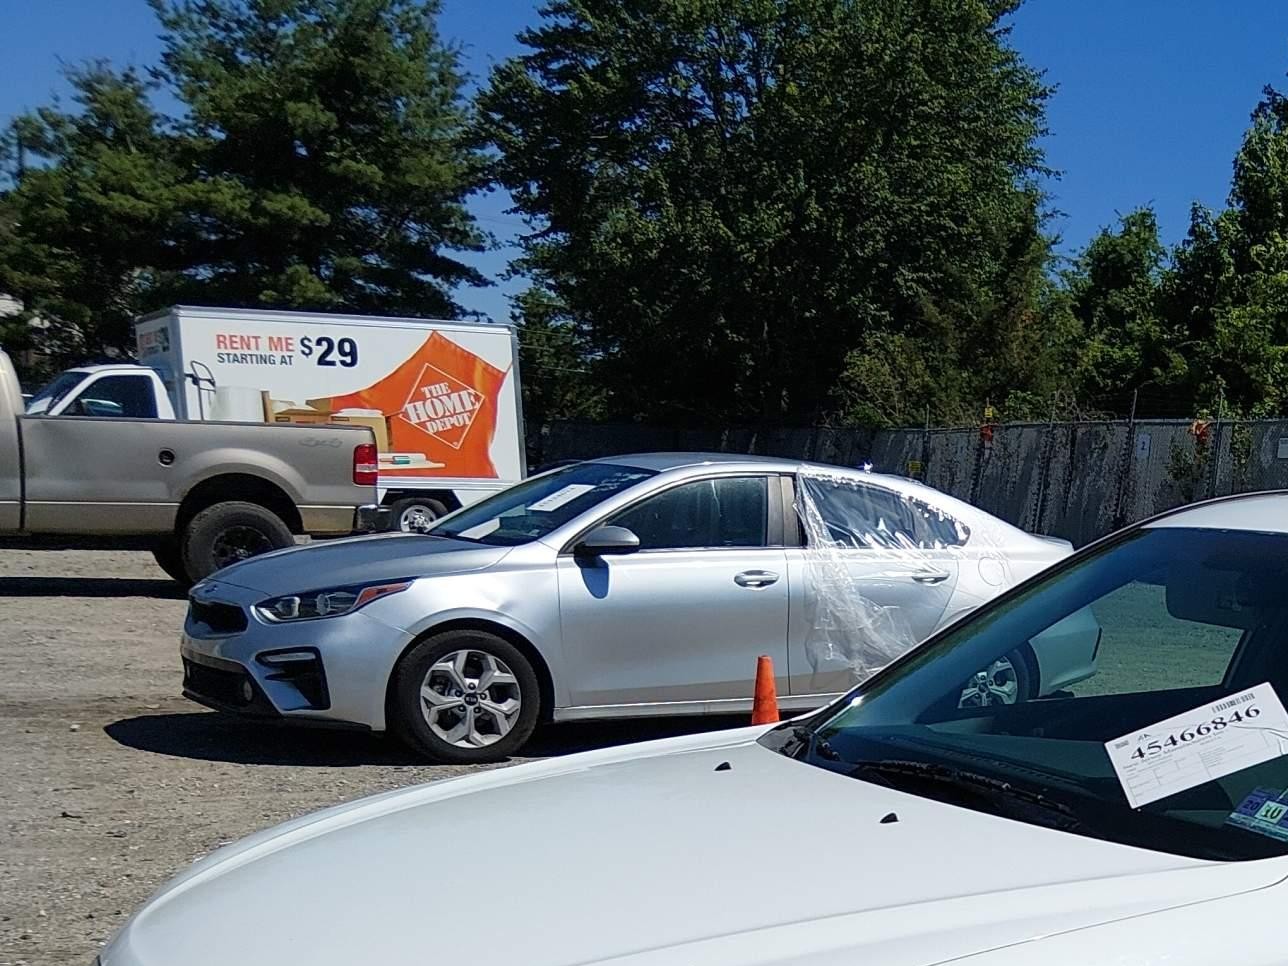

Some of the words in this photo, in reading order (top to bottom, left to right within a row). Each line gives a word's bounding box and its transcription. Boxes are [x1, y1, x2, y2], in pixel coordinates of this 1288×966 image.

[216, 334, 261, 351] RENT
[268, 336, 294, 352] ME
[300, 335, 358, 367] $29
[217, 353, 276, 365] STARTING
[280, 355, 294, 366] AT
[421, 382, 451, 398] THE
[406, 389, 479, 424] HOME
[426, 412, 471, 434] DEPOT
[1131, 703, 1261, 760] 45466846
[1243, 800, 1260, 811] 20
